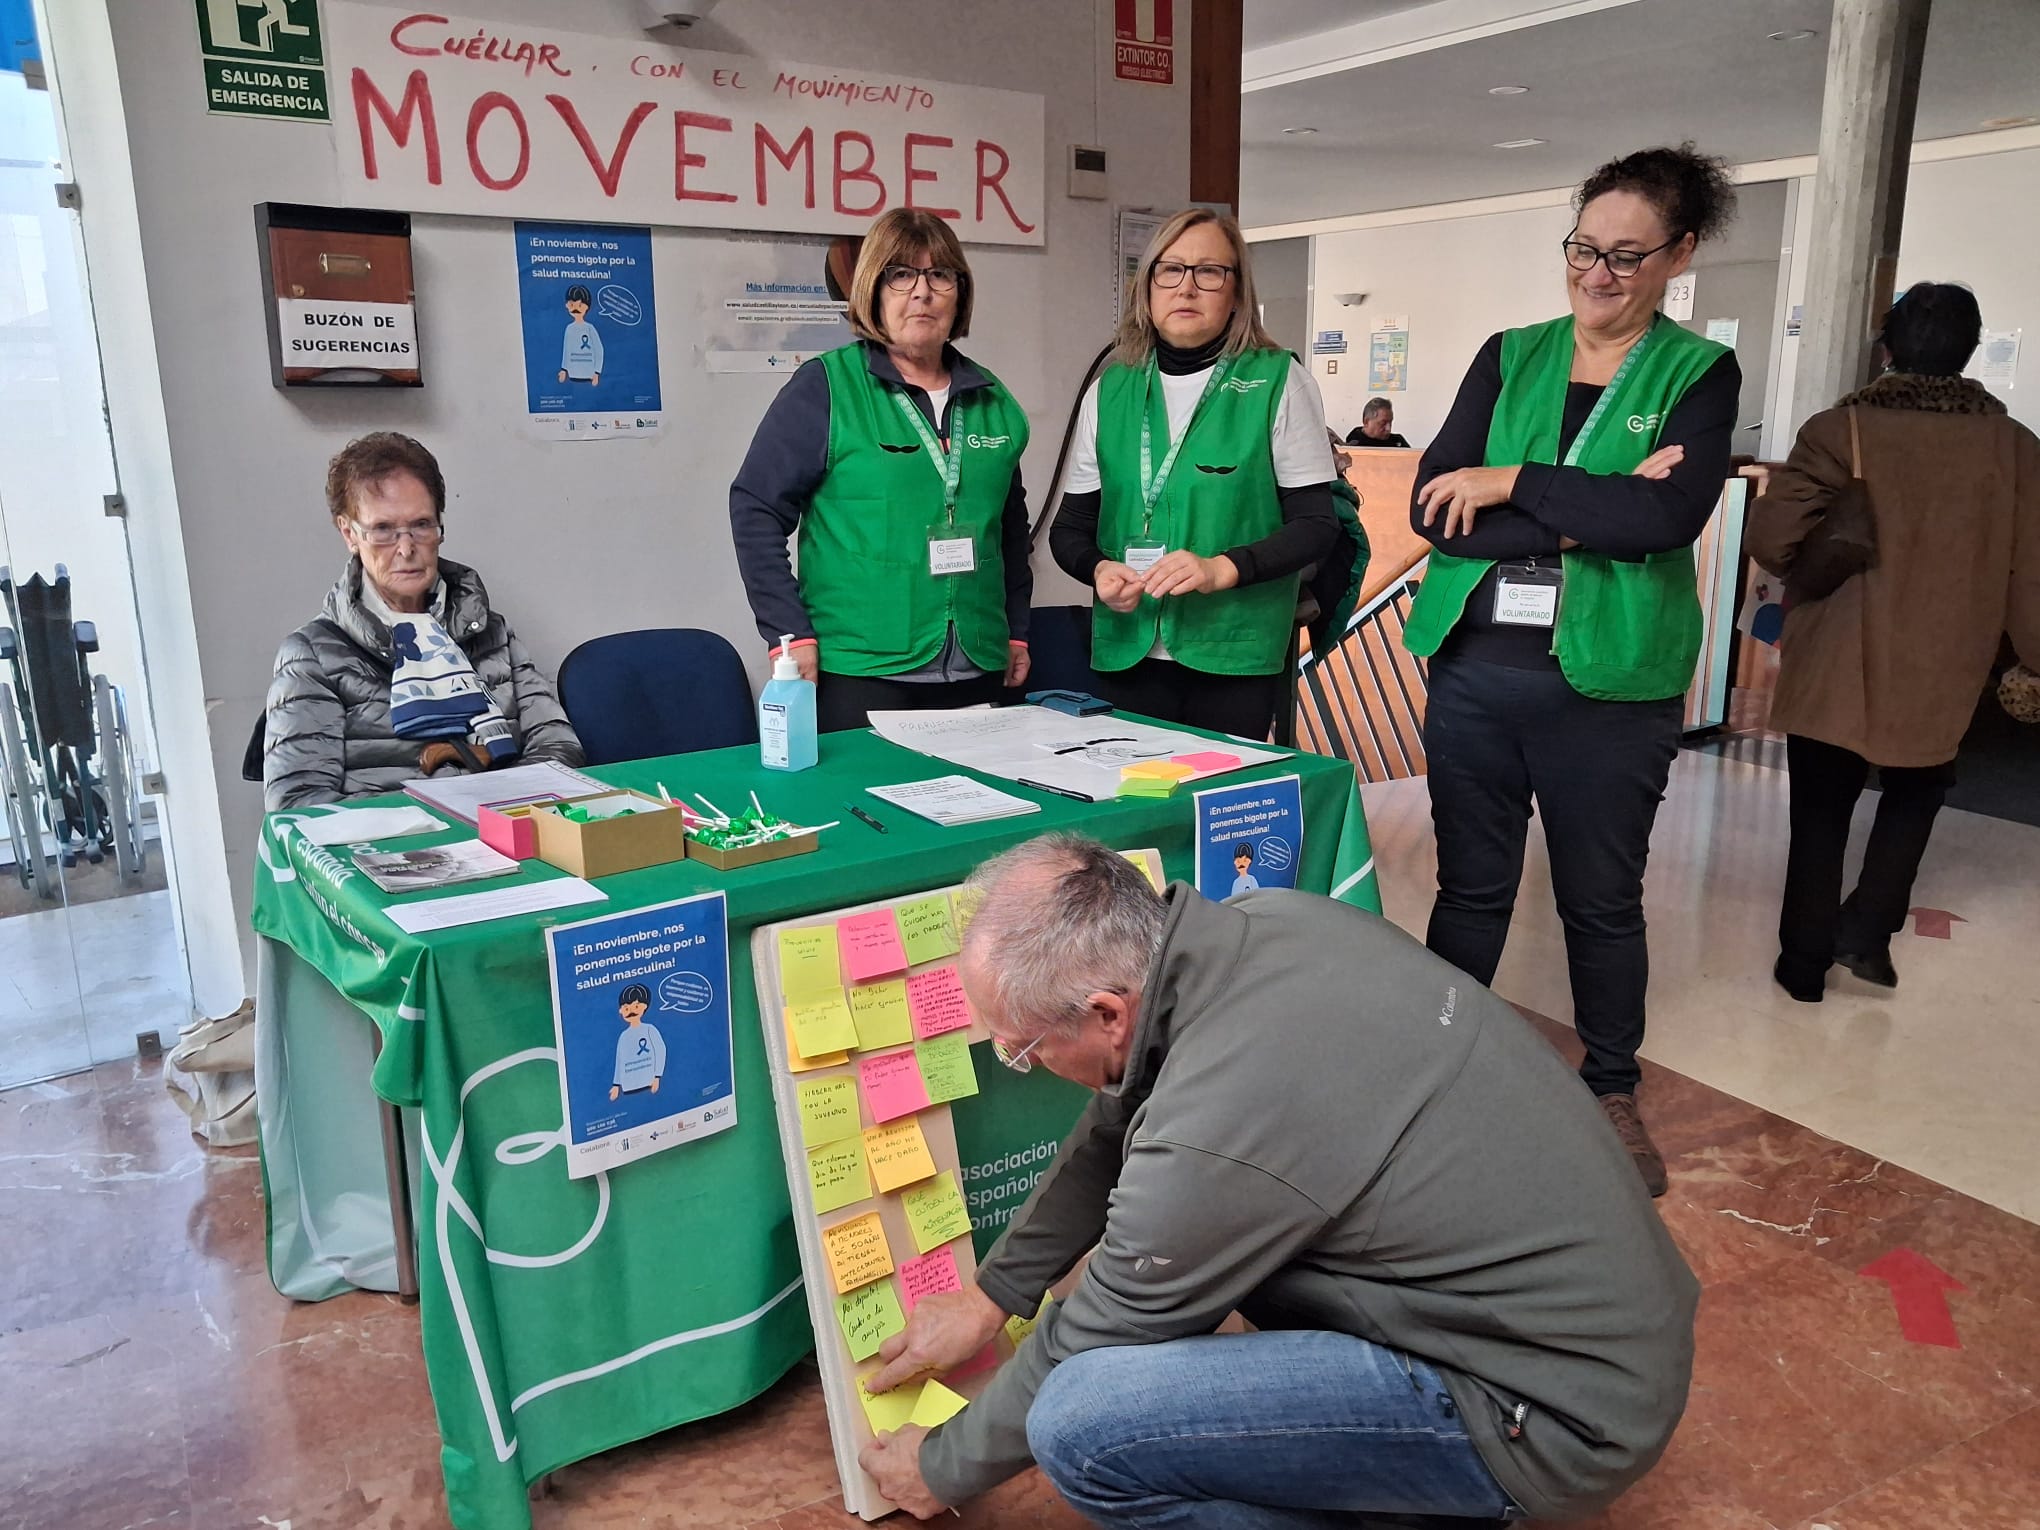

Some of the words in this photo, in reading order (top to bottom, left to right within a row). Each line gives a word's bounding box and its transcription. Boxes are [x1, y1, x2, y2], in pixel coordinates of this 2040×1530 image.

[1117, 46, 1155, 66] EXTINTOR
[221, 69, 283, 88] SALIDA
[287, 75, 310, 90] DE
[630, 55, 684, 79] CON
[713, 68, 746, 89] EL
[773, 72, 934, 112] MOVIMIENTO
[211, 89, 324, 111] EMERGENCIA
[351, 67, 1036, 234] MOVEMBER
[529, 237, 545, 247] ¡En
[547, 238, 600, 250] noviembre,
[602, 242, 618, 250] nos
[531, 255, 576, 264] ponemos
[577, 255, 607, 265] bigote
[609, 258, 625, 266] por
[627, 256, 636, 265] la
[532, 268, 559, 278] salud
[561, 270, 611, 279] masculina!
[746, 282, 762, 292] Más
[764, 282, 812, 292] información
[1672, 285, 1689, 301] 23
[303, 310, 363, 328] BUZÓN
[374, 314, 395, 328] DE
[291, 337, 410, 354] SUGERENCIAS
[935, 560, 972, 570] VOLUNTARIADO
[1502, 609, 1550, 619] VOLUNTARIADO
[1262, 798, 1276, 807] nos
[1210, 818, 1243, 831] ponemos
[1244, 811, 1267, 823] bigote
[1268, 810, 1280, 820] por
[1281, 808, 1288, 816] la
[1210, 831, 1231, 843] salud
[1231, 824, 1270, 838] masculina!
[573, 943, 593, 956] ¡En
[595, 928, 662, 951] noviembre,
[664, 922, 685, 935] nos
[575, 952, 631, 976] ponemos
[633, 942, 671, 960] bigote
[673, 938, 692, 953] por
[695, 934, 706, 944] la
[576, 971, 610, 991] salud
[612, 957, 676, 982] masculina!
[964, 1169, 1045, 1209] spañol
